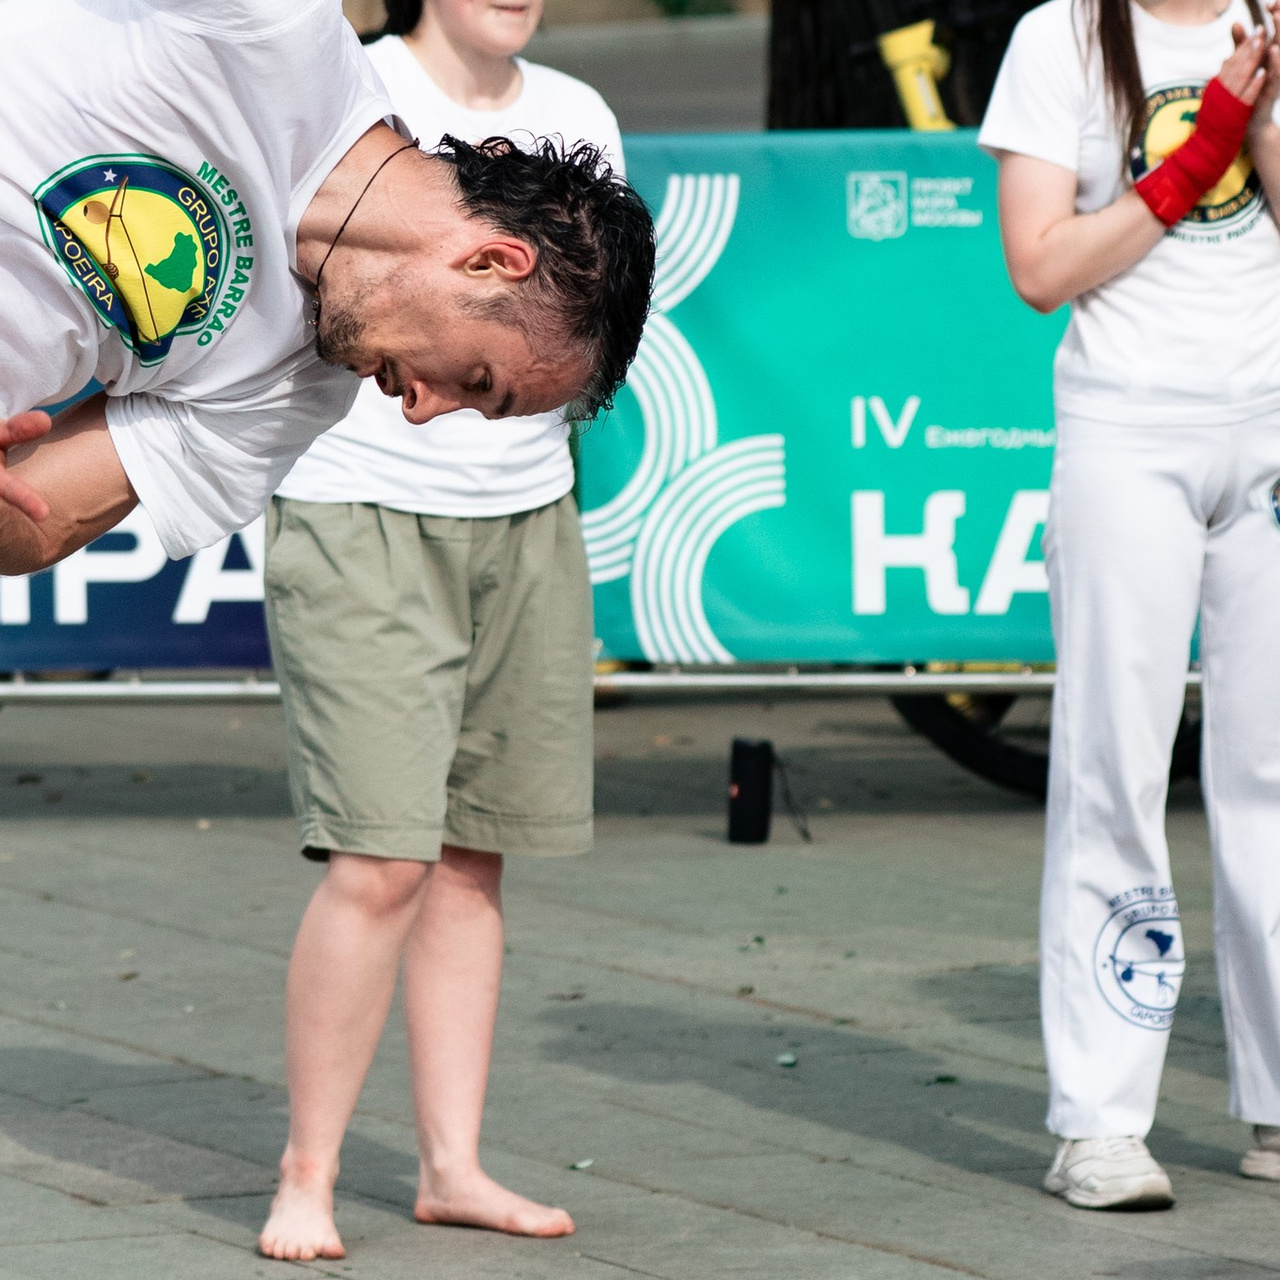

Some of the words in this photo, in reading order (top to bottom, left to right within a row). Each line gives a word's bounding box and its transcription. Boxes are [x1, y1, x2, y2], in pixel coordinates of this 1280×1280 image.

[178, 186, 219, 268] GRUPO
[196, 161, 253, 249] MESTRE
[53, 219, 115, 311] POEIRA
[197, 255, 254, 346] BARRÃO
[851, 395, 921, 448] IV
